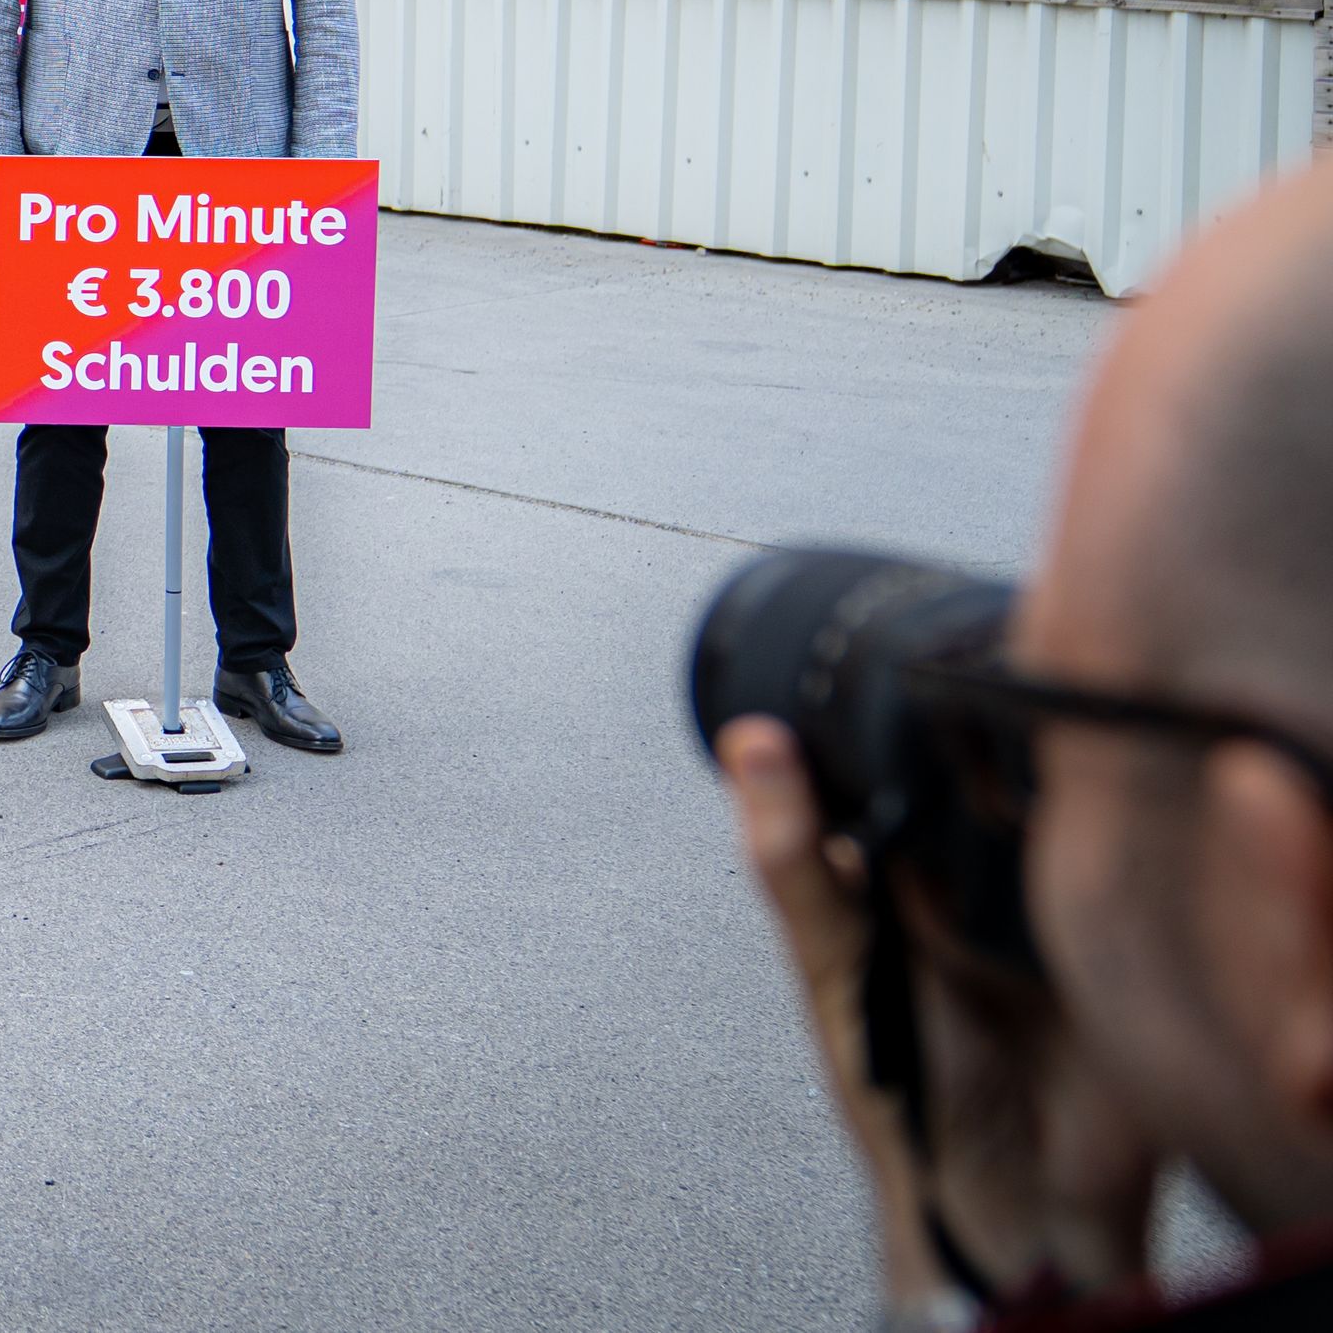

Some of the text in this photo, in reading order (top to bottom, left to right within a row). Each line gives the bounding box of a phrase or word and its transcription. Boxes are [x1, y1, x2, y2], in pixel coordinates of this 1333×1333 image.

[18, 193, 347, 246] Pro Minute
[67, 267, 291, 320] € 3.800
[40, 341, 314, 395] Schulden
